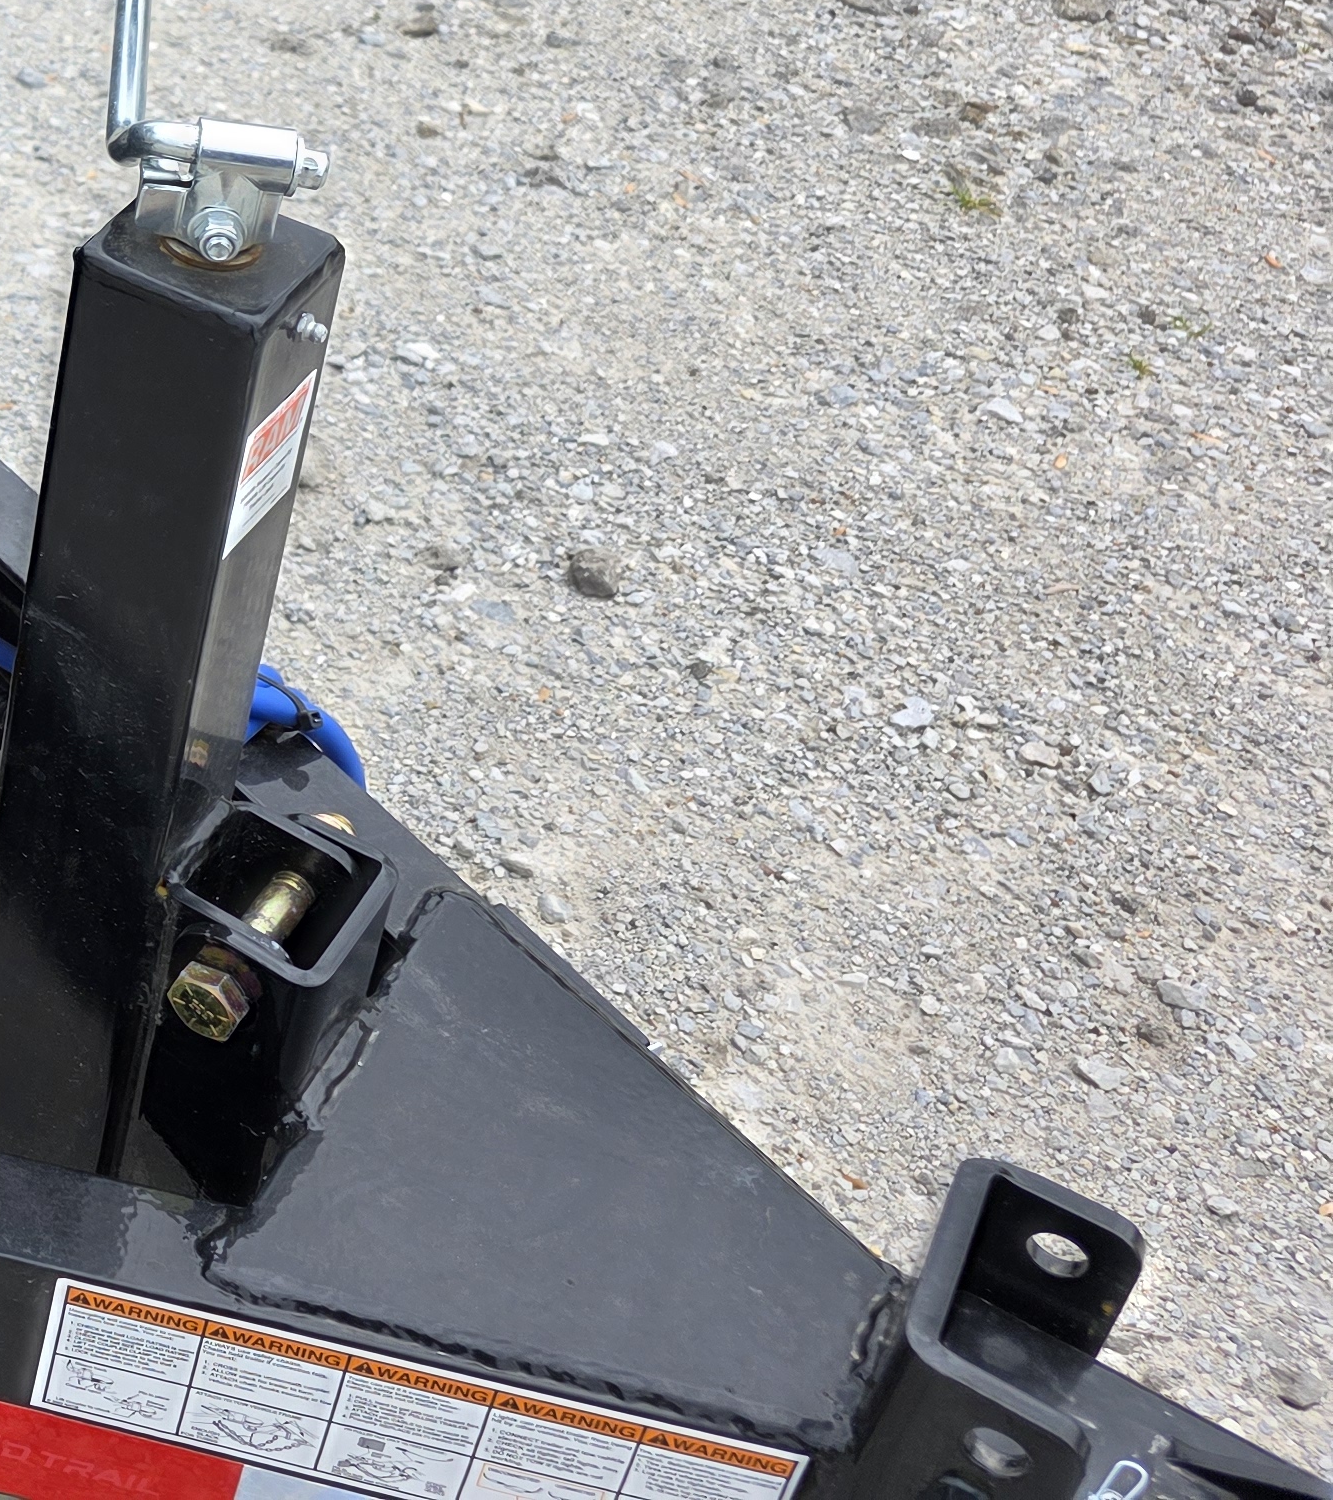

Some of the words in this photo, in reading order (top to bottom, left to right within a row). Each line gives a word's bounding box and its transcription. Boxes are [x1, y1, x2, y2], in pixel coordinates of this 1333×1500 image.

[92, 1296, 199, 1332] WARNING
[203, 1339, 236, 1351] ALWAYS
[233, 1331, 341, 1367] WARNING
[377, 1366, 489, 1403] WARNING
[523, 1402, 637, 1438] WARNING
[40, 1449, 162, 1496] TRAIL
[673, 1438, 788, 1475] WARNING
